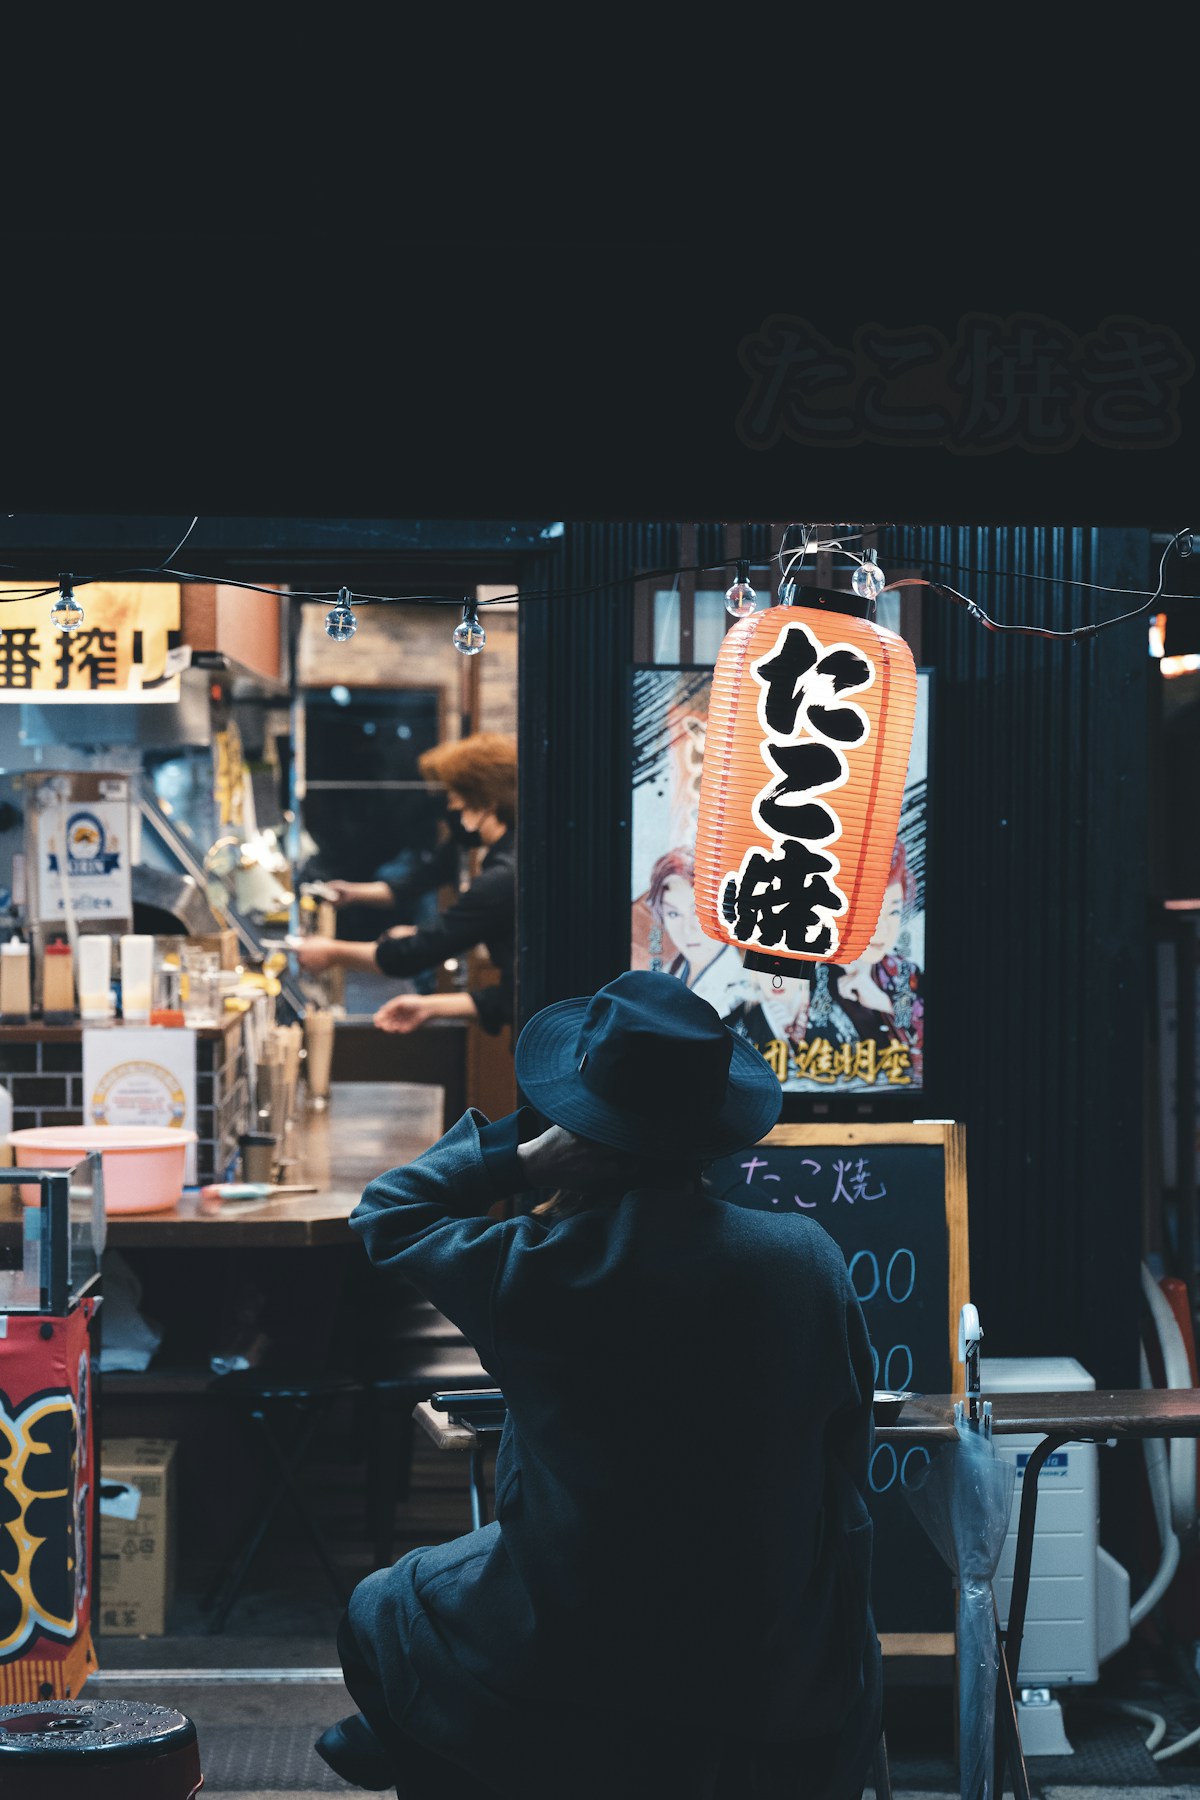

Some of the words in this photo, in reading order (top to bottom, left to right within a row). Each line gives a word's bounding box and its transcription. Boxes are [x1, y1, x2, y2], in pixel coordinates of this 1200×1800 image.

[744, 319, 1188, 449] たこ焼き
[721, 624, 873, 956] たこ焼
[739, 1156, 888, 1209] たこ焼
